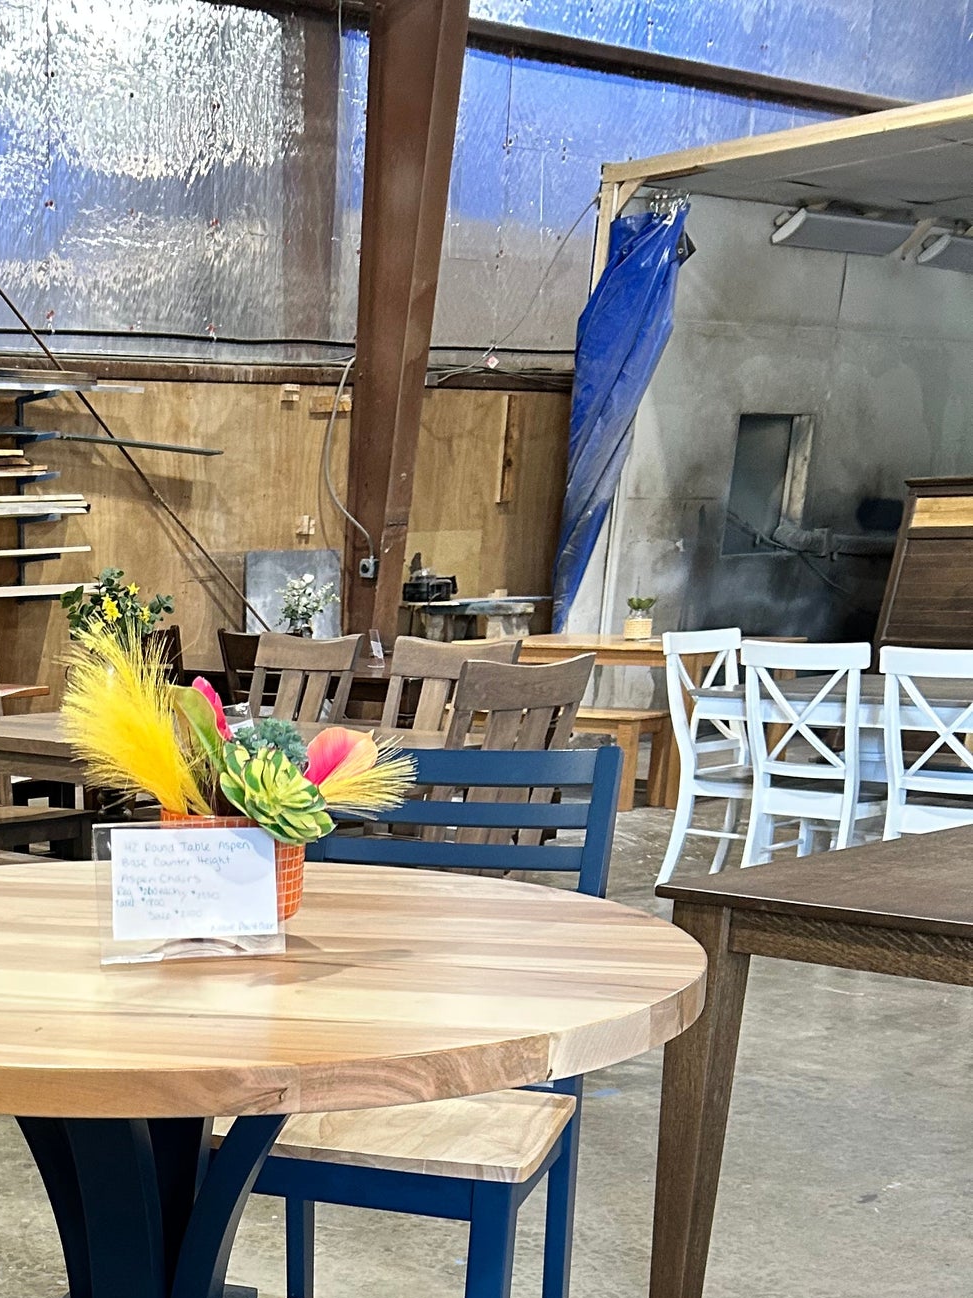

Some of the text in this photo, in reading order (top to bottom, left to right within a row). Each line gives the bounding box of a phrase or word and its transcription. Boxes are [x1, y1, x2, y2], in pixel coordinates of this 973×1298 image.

[144, 841, 175, 853] Round
[179, 841, 211, 852] Table
[218, 840, 251, 853] Aspen
[121, 857, 147, 868] Base
[197, 855, 231, 872] Height
[159, 873, 201, 884] Chairs
